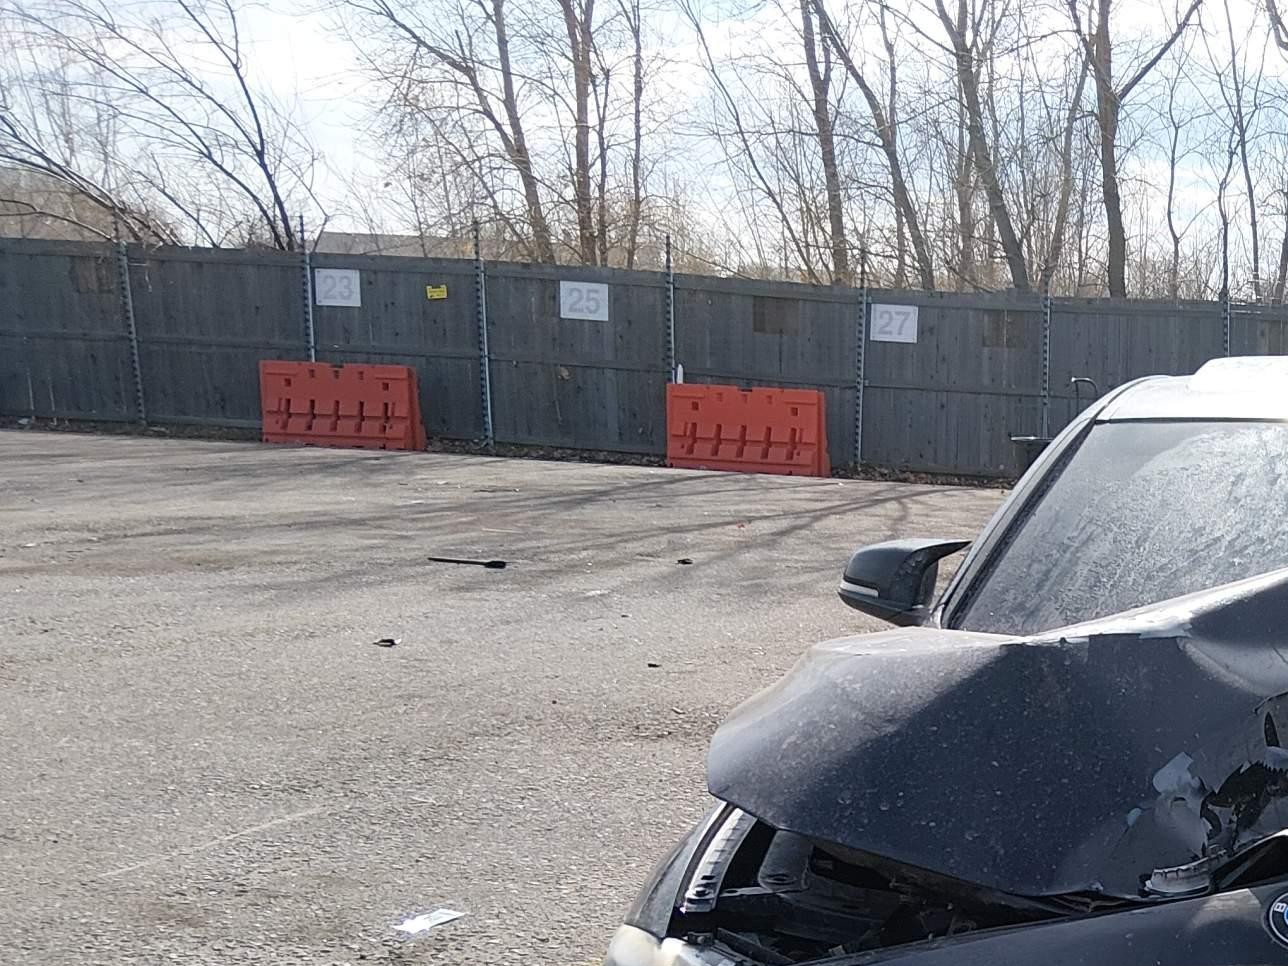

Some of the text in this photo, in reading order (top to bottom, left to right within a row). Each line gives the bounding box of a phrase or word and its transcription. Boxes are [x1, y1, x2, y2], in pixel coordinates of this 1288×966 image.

[322, 275, 353, 300] 23
[568, 288, 600, 314] 25
[878, 311, 911, 336] 27
